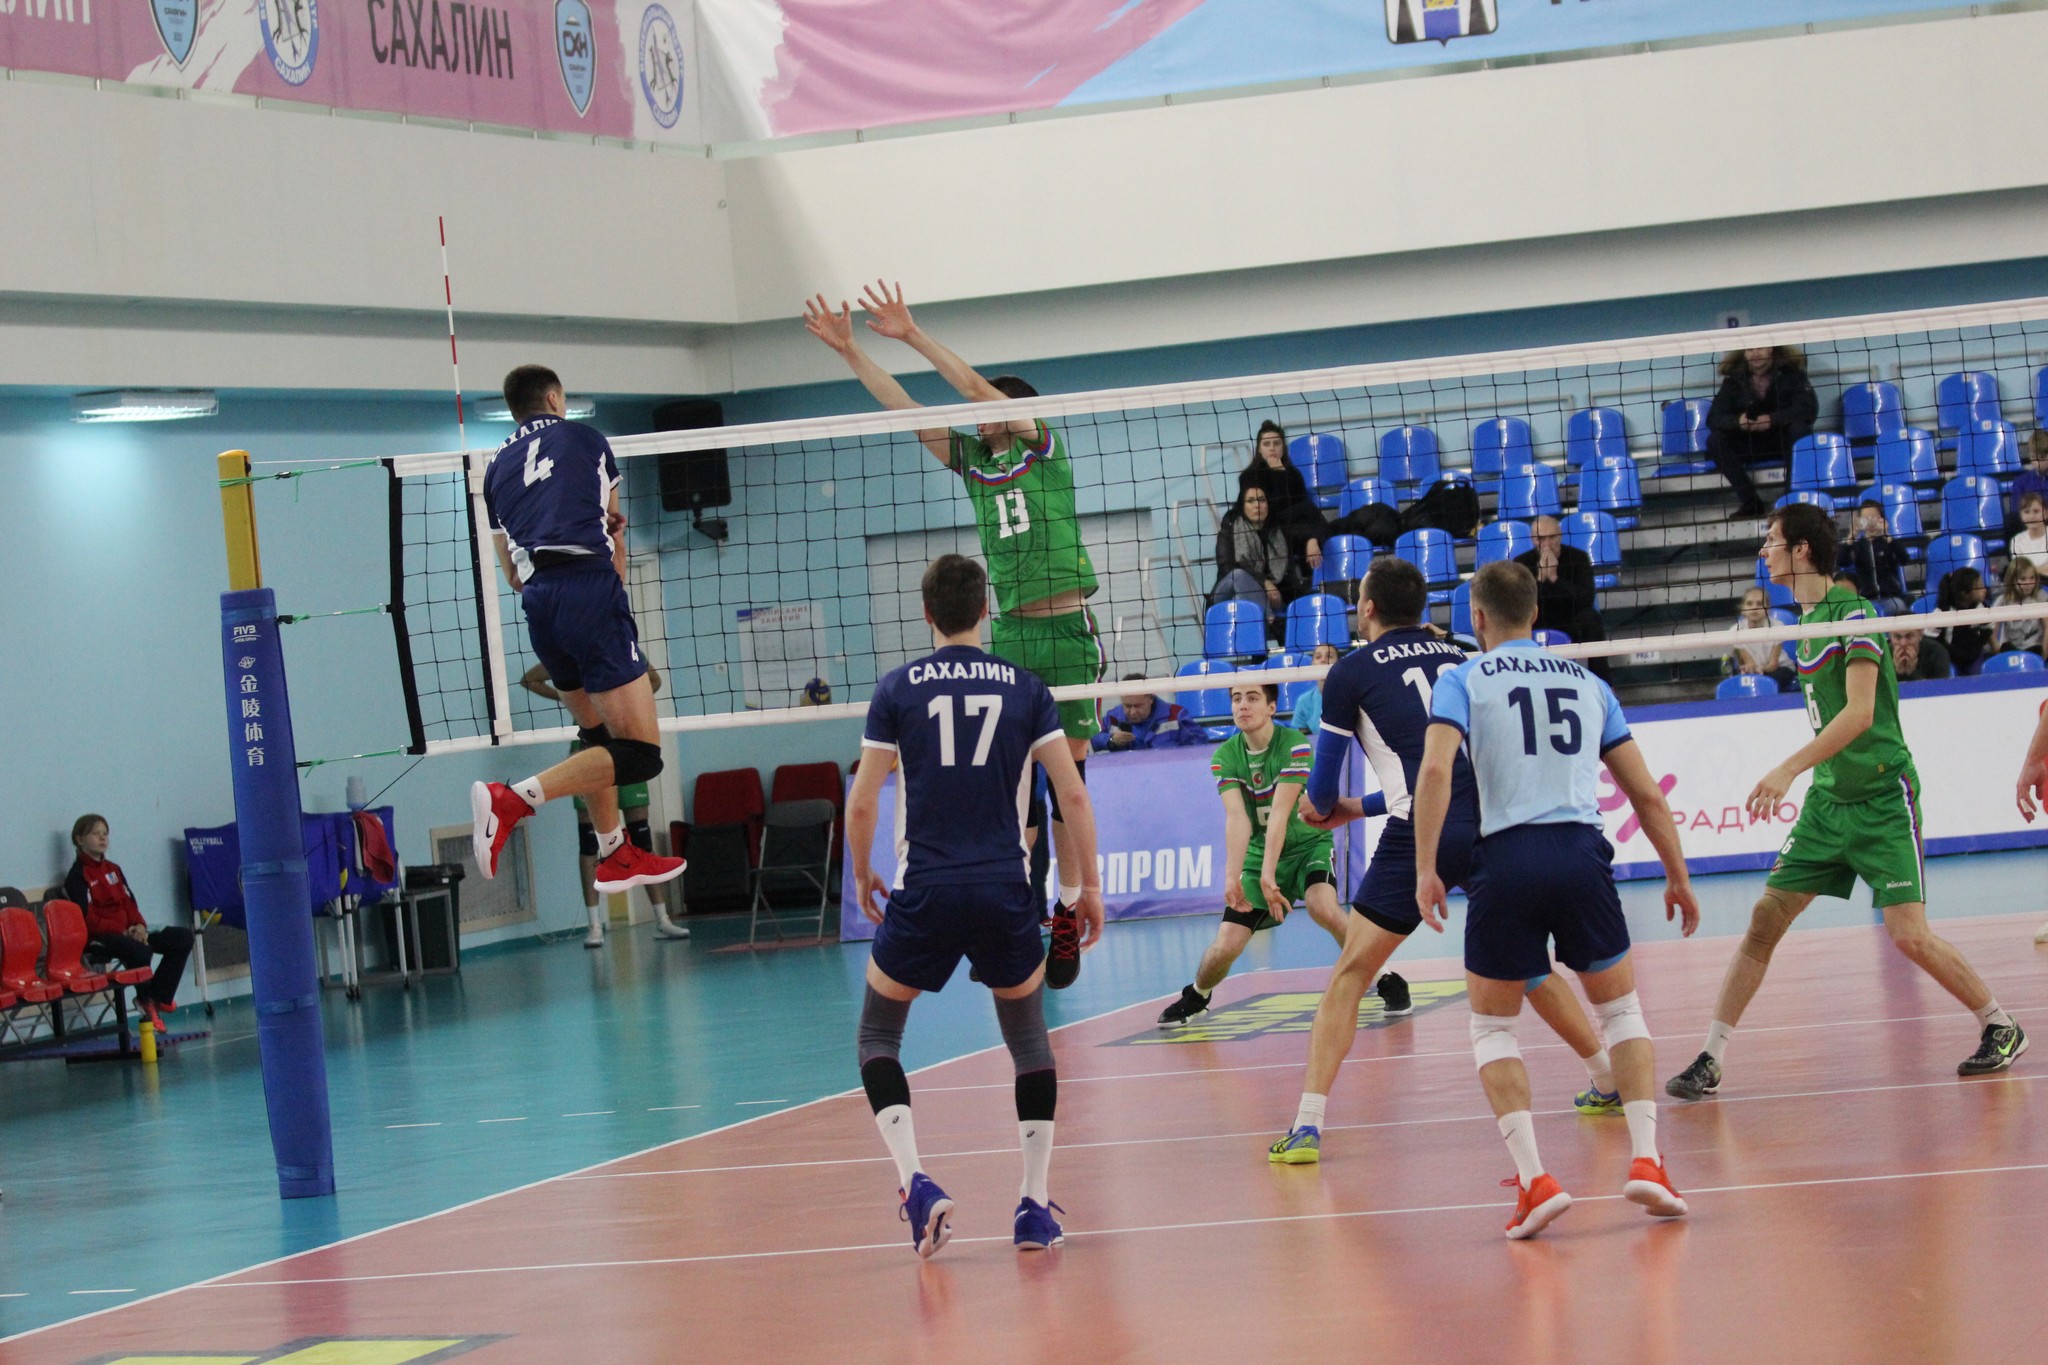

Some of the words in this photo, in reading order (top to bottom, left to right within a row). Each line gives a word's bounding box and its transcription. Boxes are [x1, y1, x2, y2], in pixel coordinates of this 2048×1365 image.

[367, 0, 514, 80] САХАЛИН
[523, 437, 555, 487] 4
[995, 487, 1030, 539] 13
[233, 624, 256, 636] FIVB
[631, 640, 640, 663] 4
[1372, 641, 1464, 664] САХАЛИН
[908, 661, 1016, 685] САХАЛИН
[1401, 662, 1458, 718] 1
[1480, 656, 1586, 680] САХАЛИН
[240, 674, 265, 767] 金陵体育
[927, 694, 1003, 766] 17
[1508, 686, 1582, 755] 15
[1805, 683, 1822, 729] 6
[1781, 837, 1795, 855] 6
